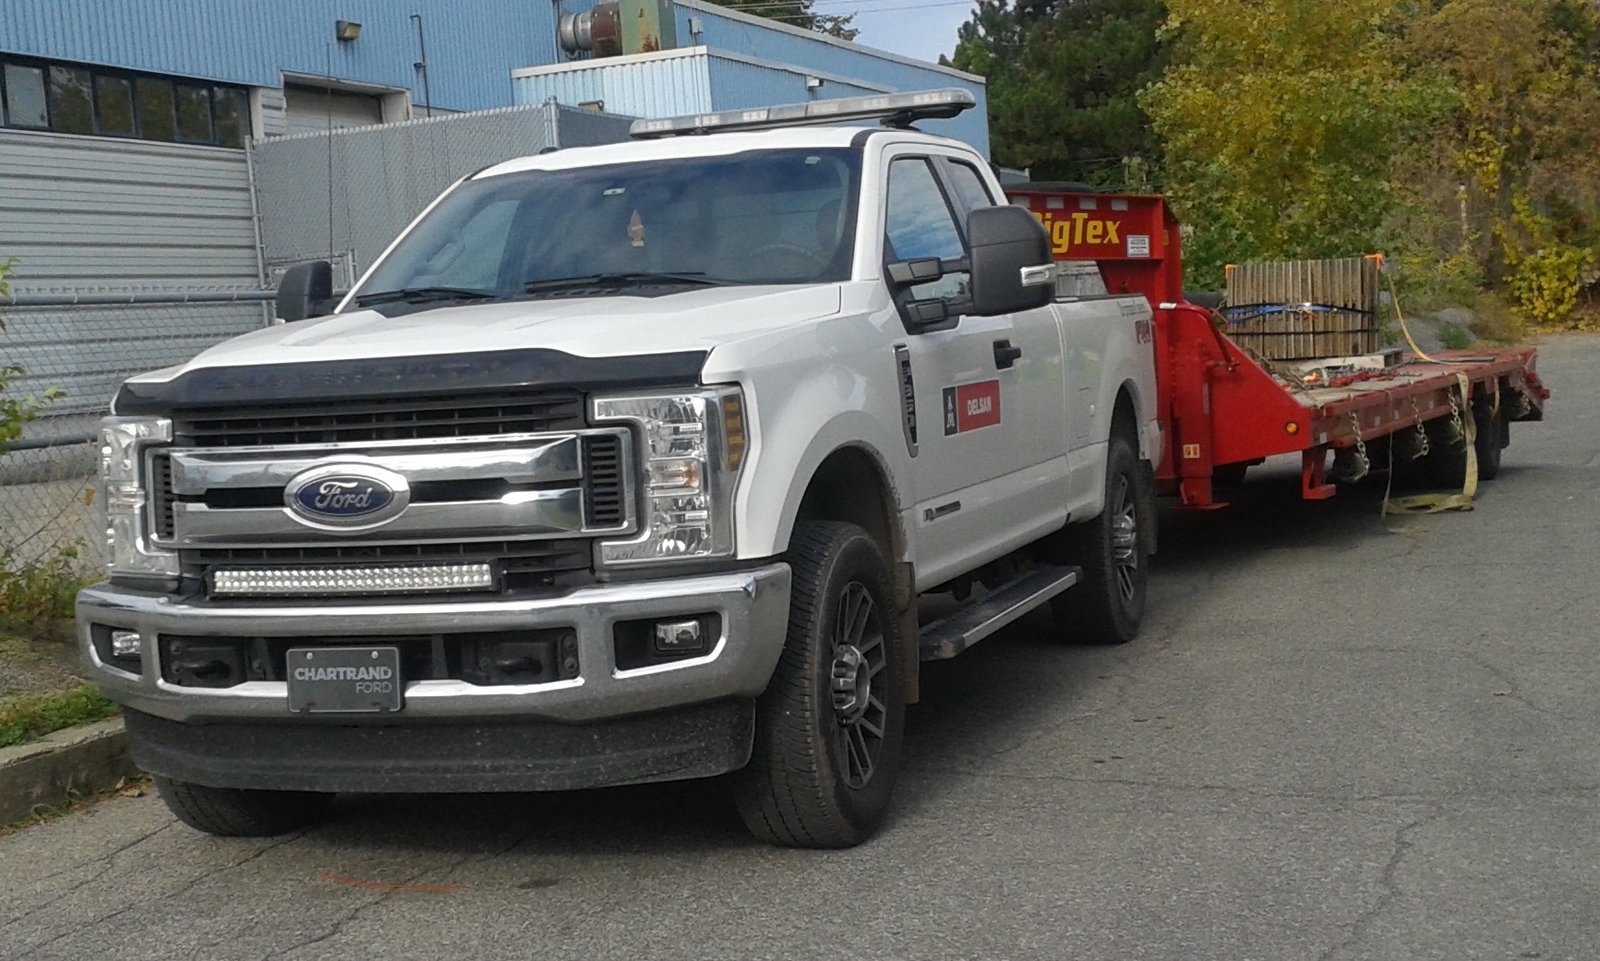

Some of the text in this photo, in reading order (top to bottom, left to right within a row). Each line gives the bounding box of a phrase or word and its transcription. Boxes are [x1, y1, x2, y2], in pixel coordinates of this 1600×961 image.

[1031, 212, 1121, 254] igTex
[315, 481, 373, 508] Ford
[294, 667, 392, 681] CHARTRAND
[356, 682, 392, 693] FORD
